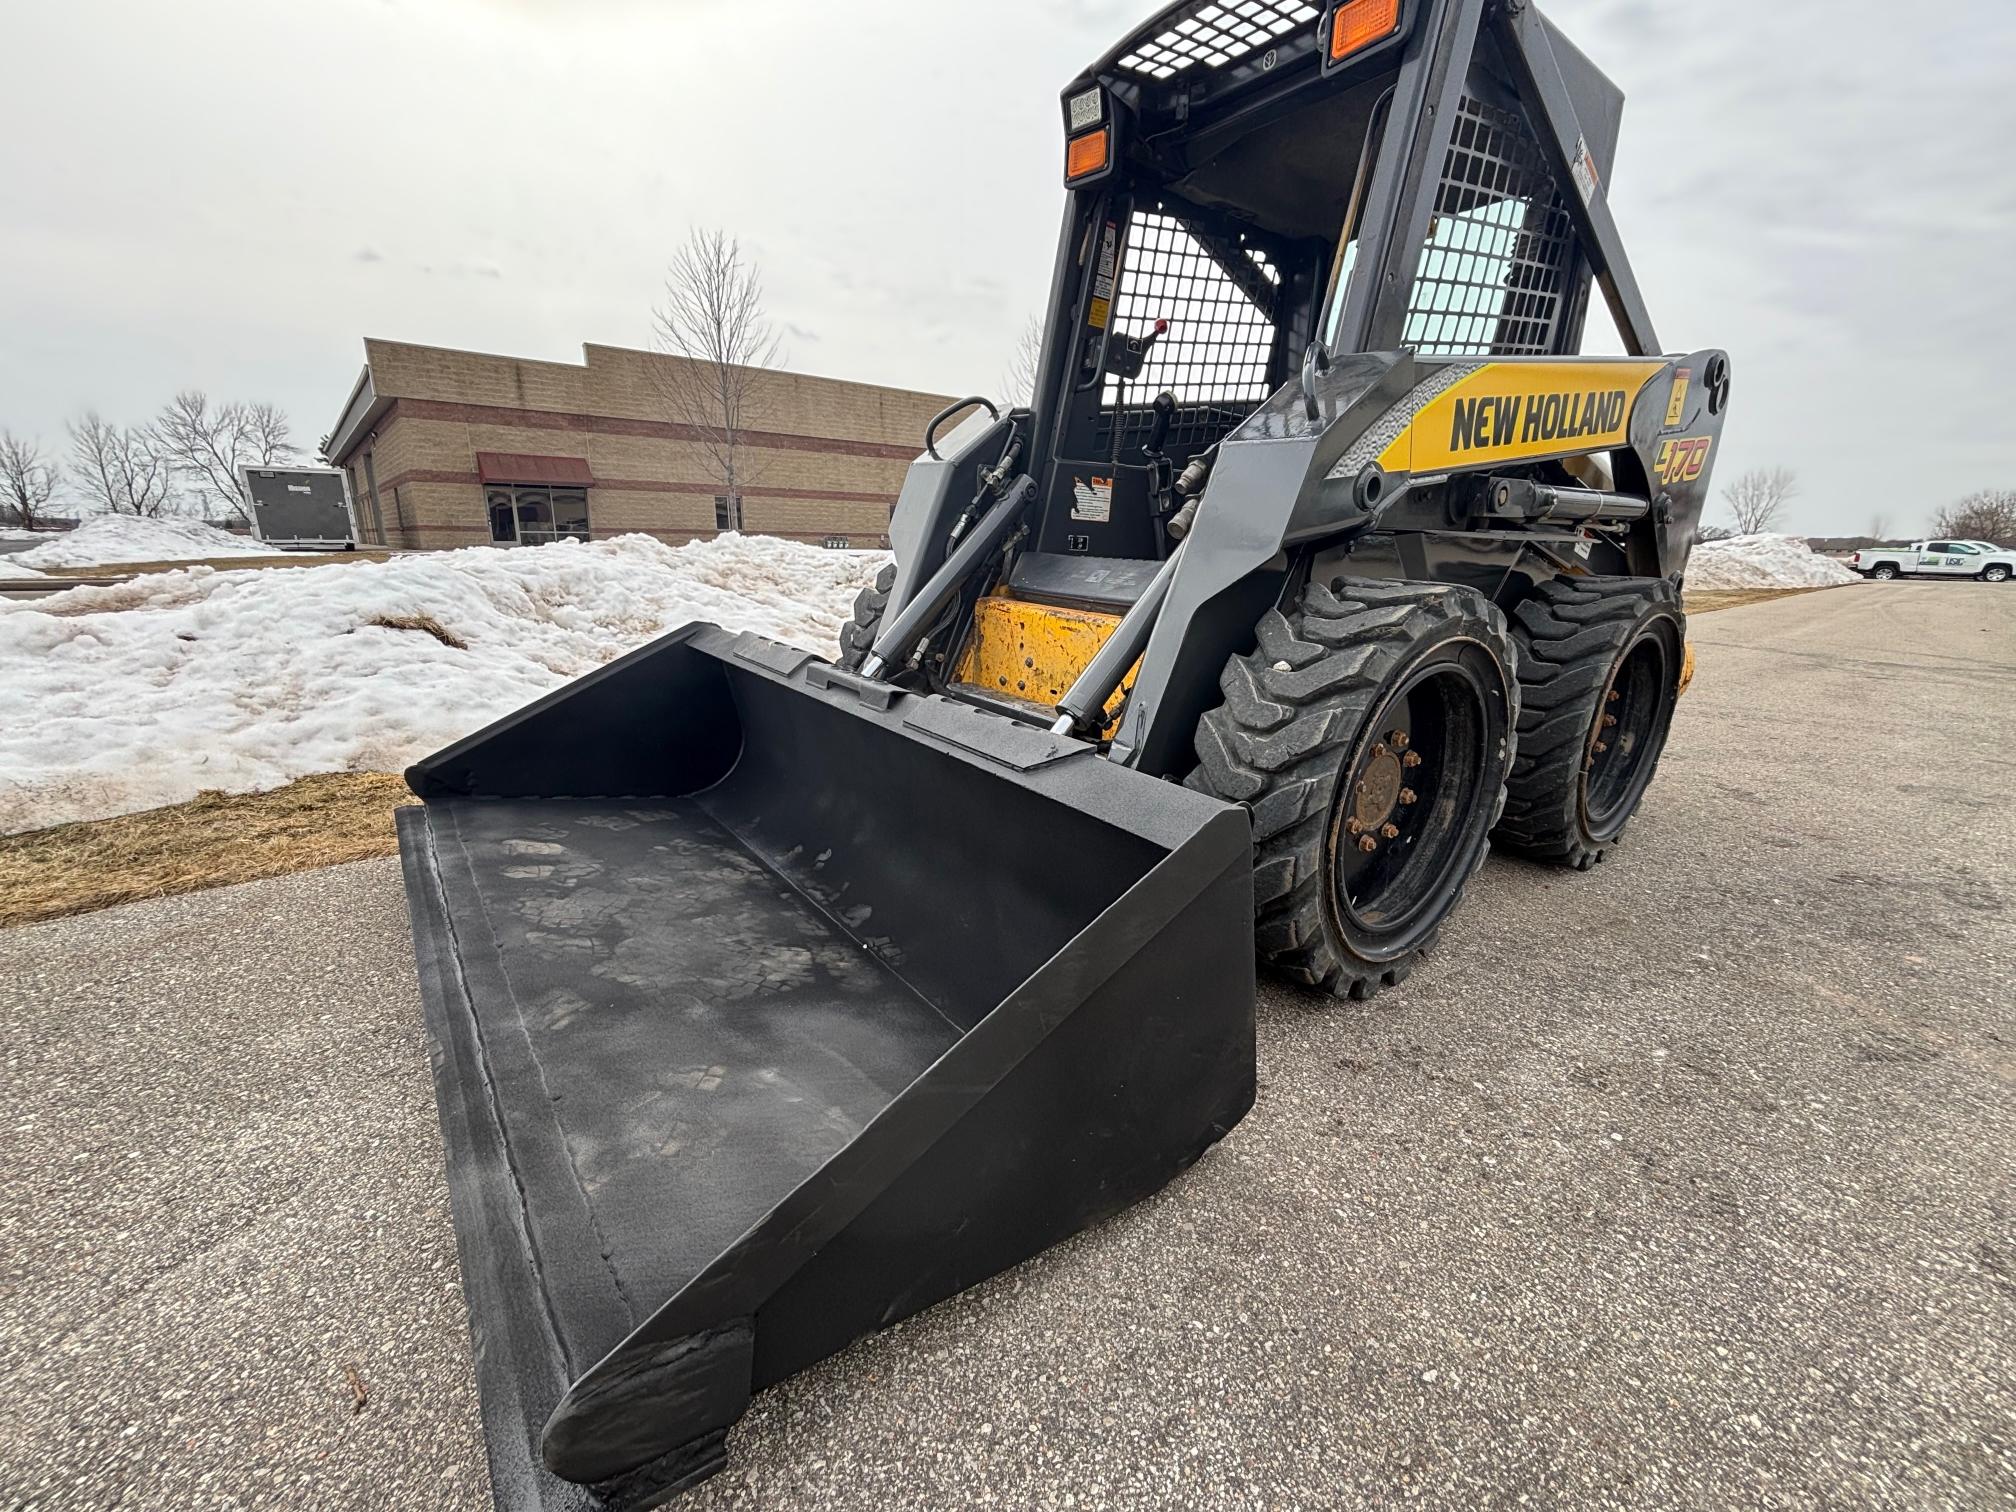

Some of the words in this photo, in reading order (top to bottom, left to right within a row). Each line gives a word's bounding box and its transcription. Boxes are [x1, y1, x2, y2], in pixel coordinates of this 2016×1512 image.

[1450, 395, 1521, 452] NEW
[1521, 390, 1626, 443] HOLLAND
[1655, 438, 1710, 482] L170
